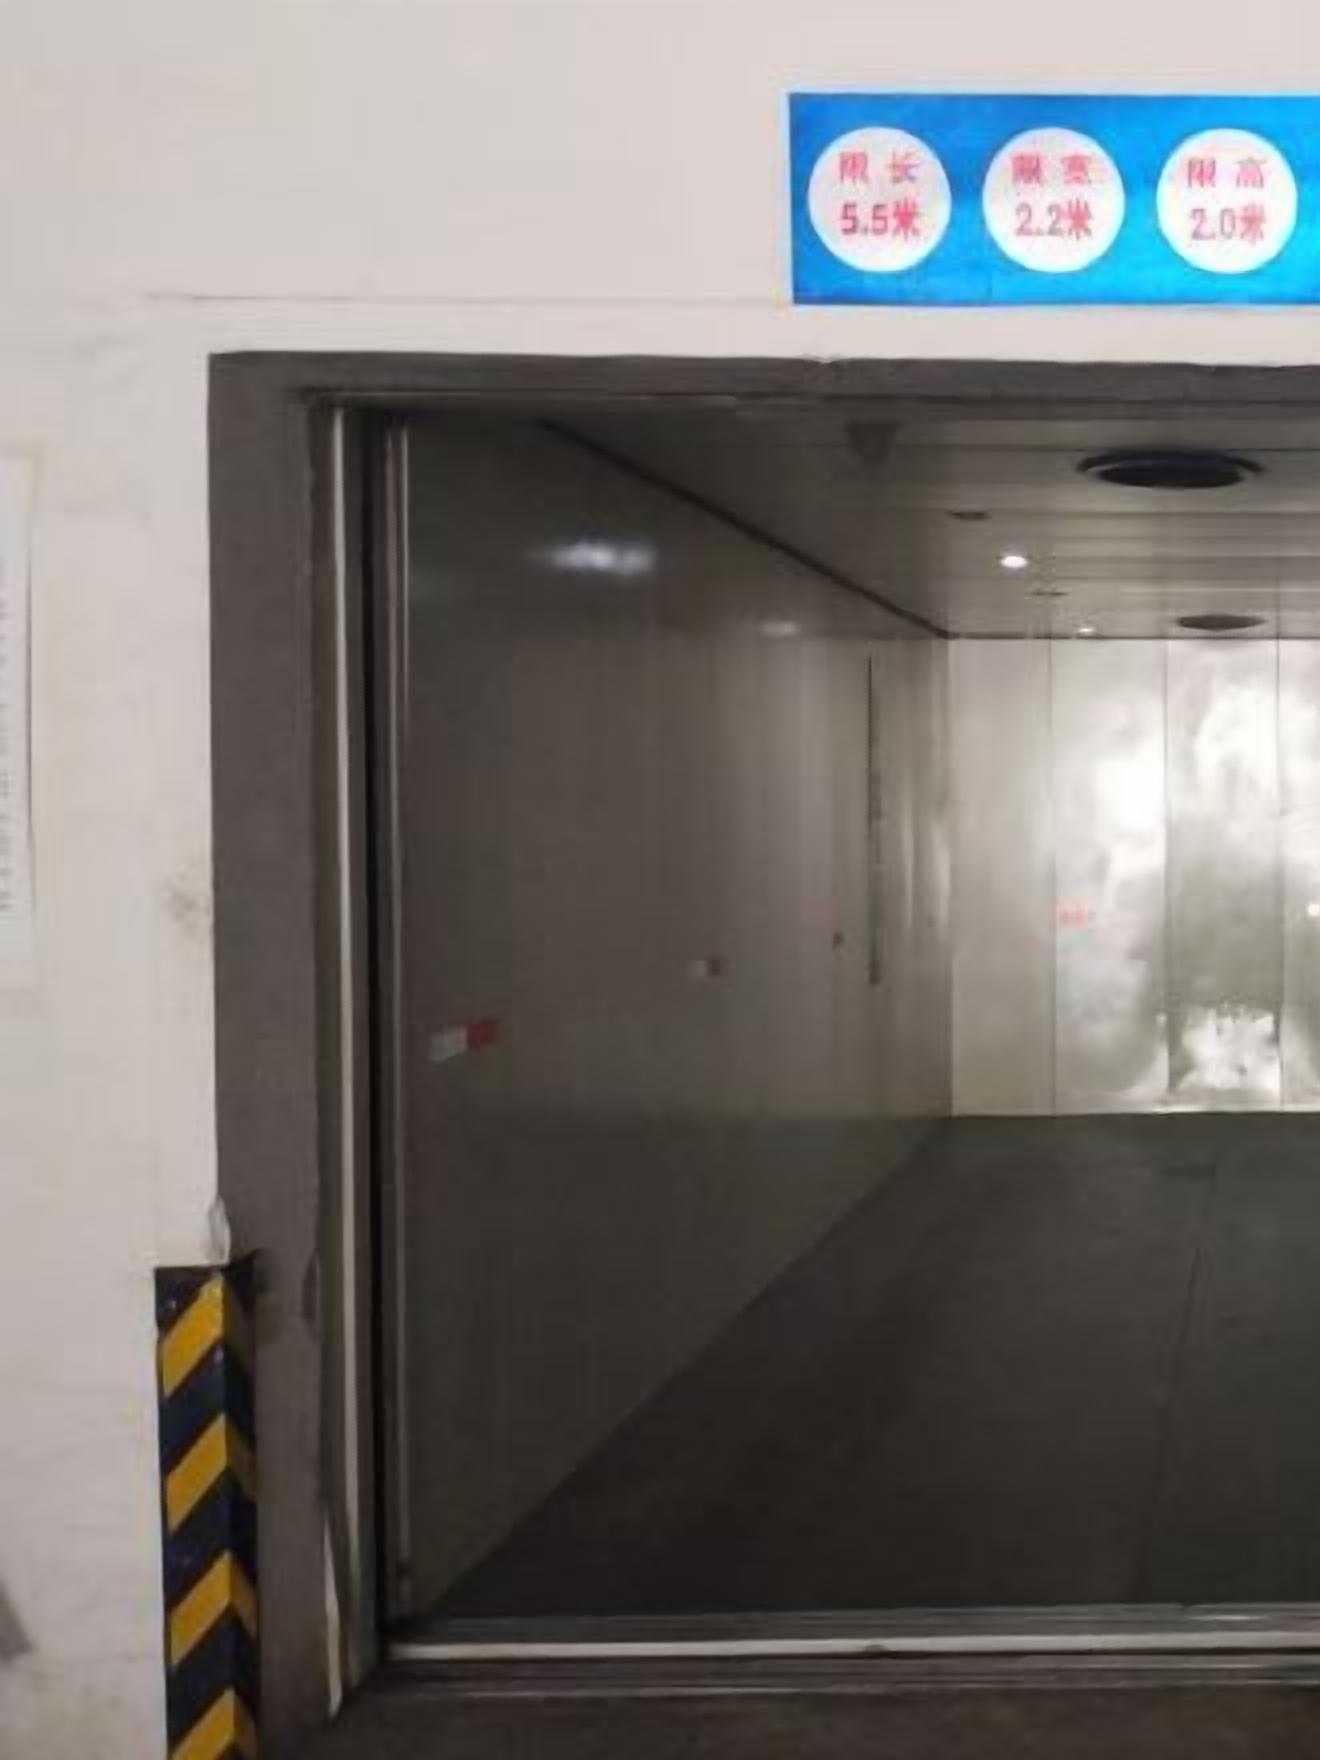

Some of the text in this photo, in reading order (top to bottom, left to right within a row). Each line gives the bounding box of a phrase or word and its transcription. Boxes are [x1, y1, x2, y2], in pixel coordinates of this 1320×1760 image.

[839, 151, 920, 184] 限长
[1187, 157, 1267, 187] 限高
[840, 199, 920, 240] 5.5米
[1014, 199, 1092, 240] 2.2米
[1190, 205, 1266, 243] 2.0米
